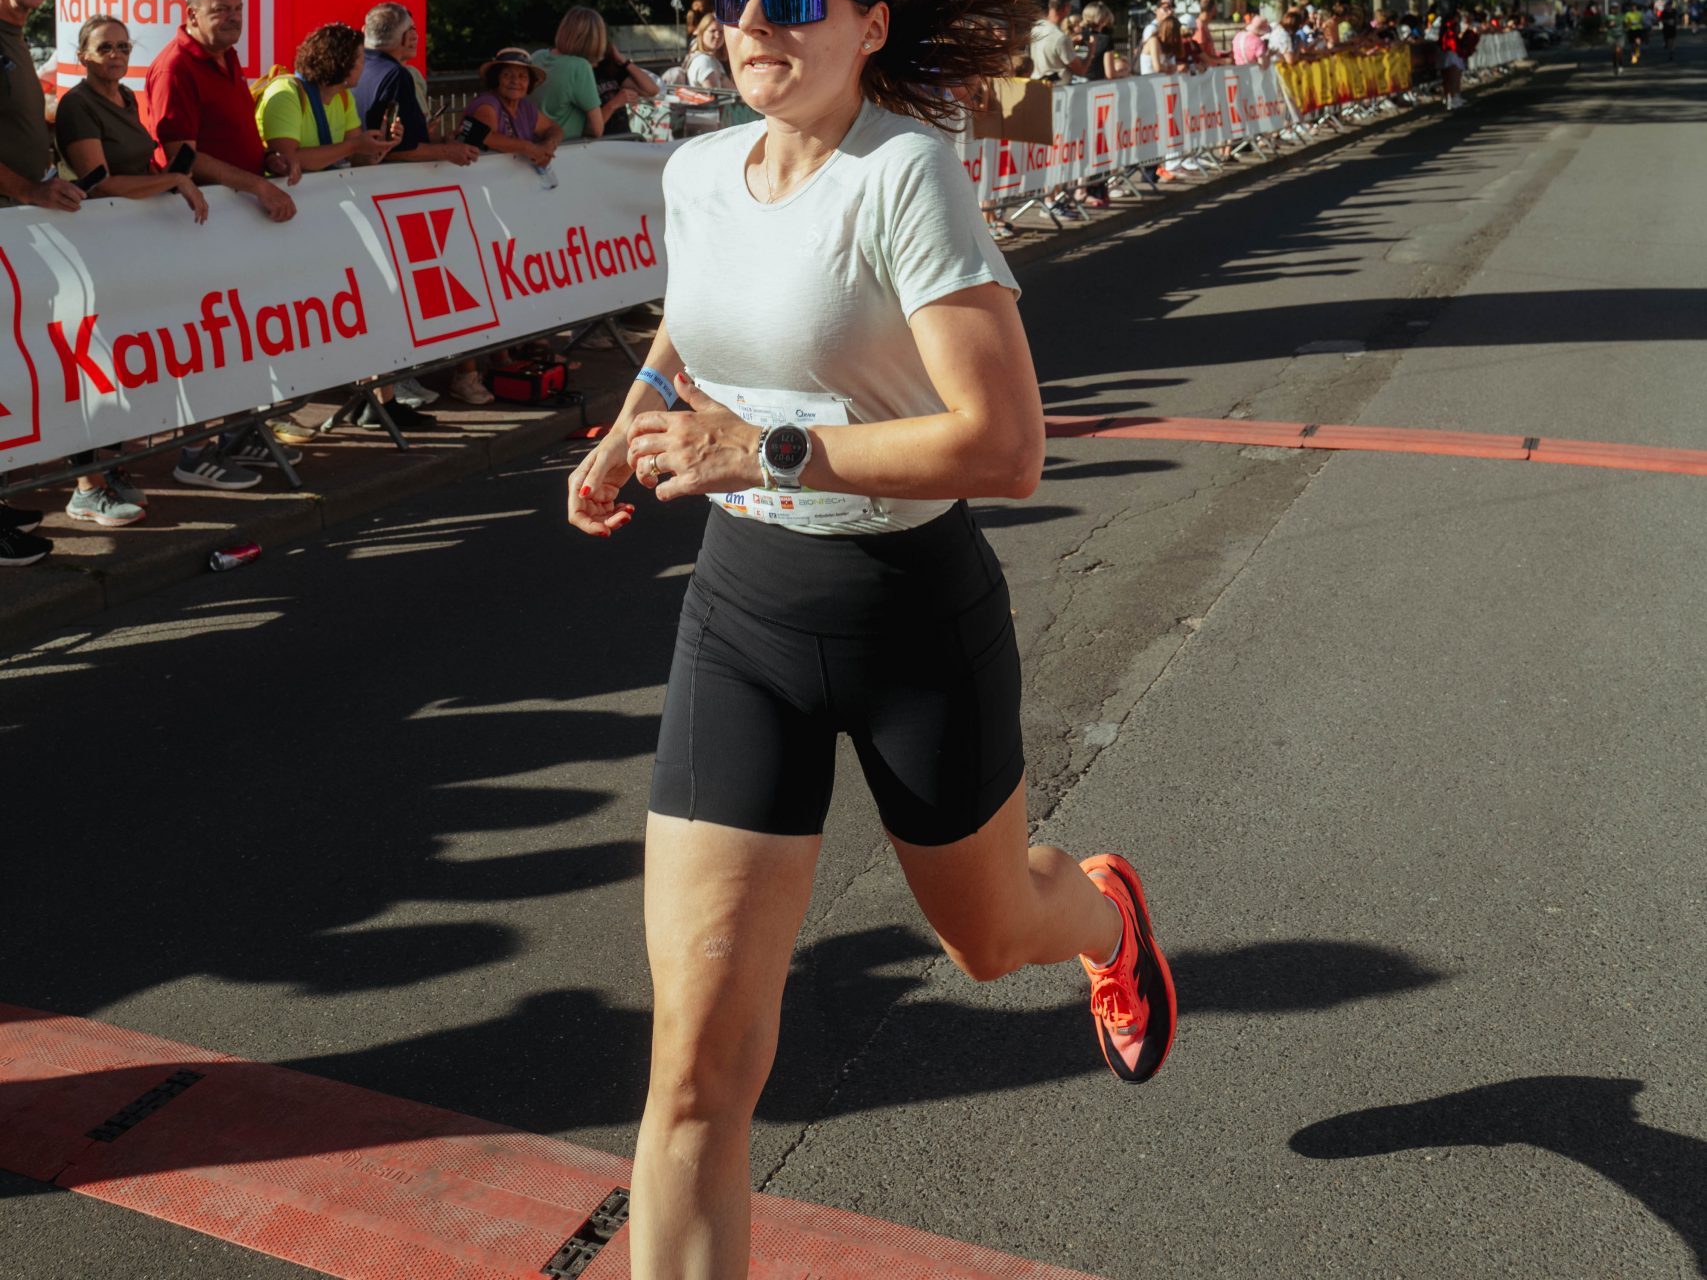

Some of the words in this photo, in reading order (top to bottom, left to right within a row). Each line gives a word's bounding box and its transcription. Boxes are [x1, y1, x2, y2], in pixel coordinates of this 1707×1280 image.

[1026, 128, 1086, 172] Kaufland
[1115, 114, 1160, 152] Kaufland
[48, 267, 368, 402] Kaufland
[492, 215, 656, 300] Kaufland
[725, 492, 745, 505] dm
